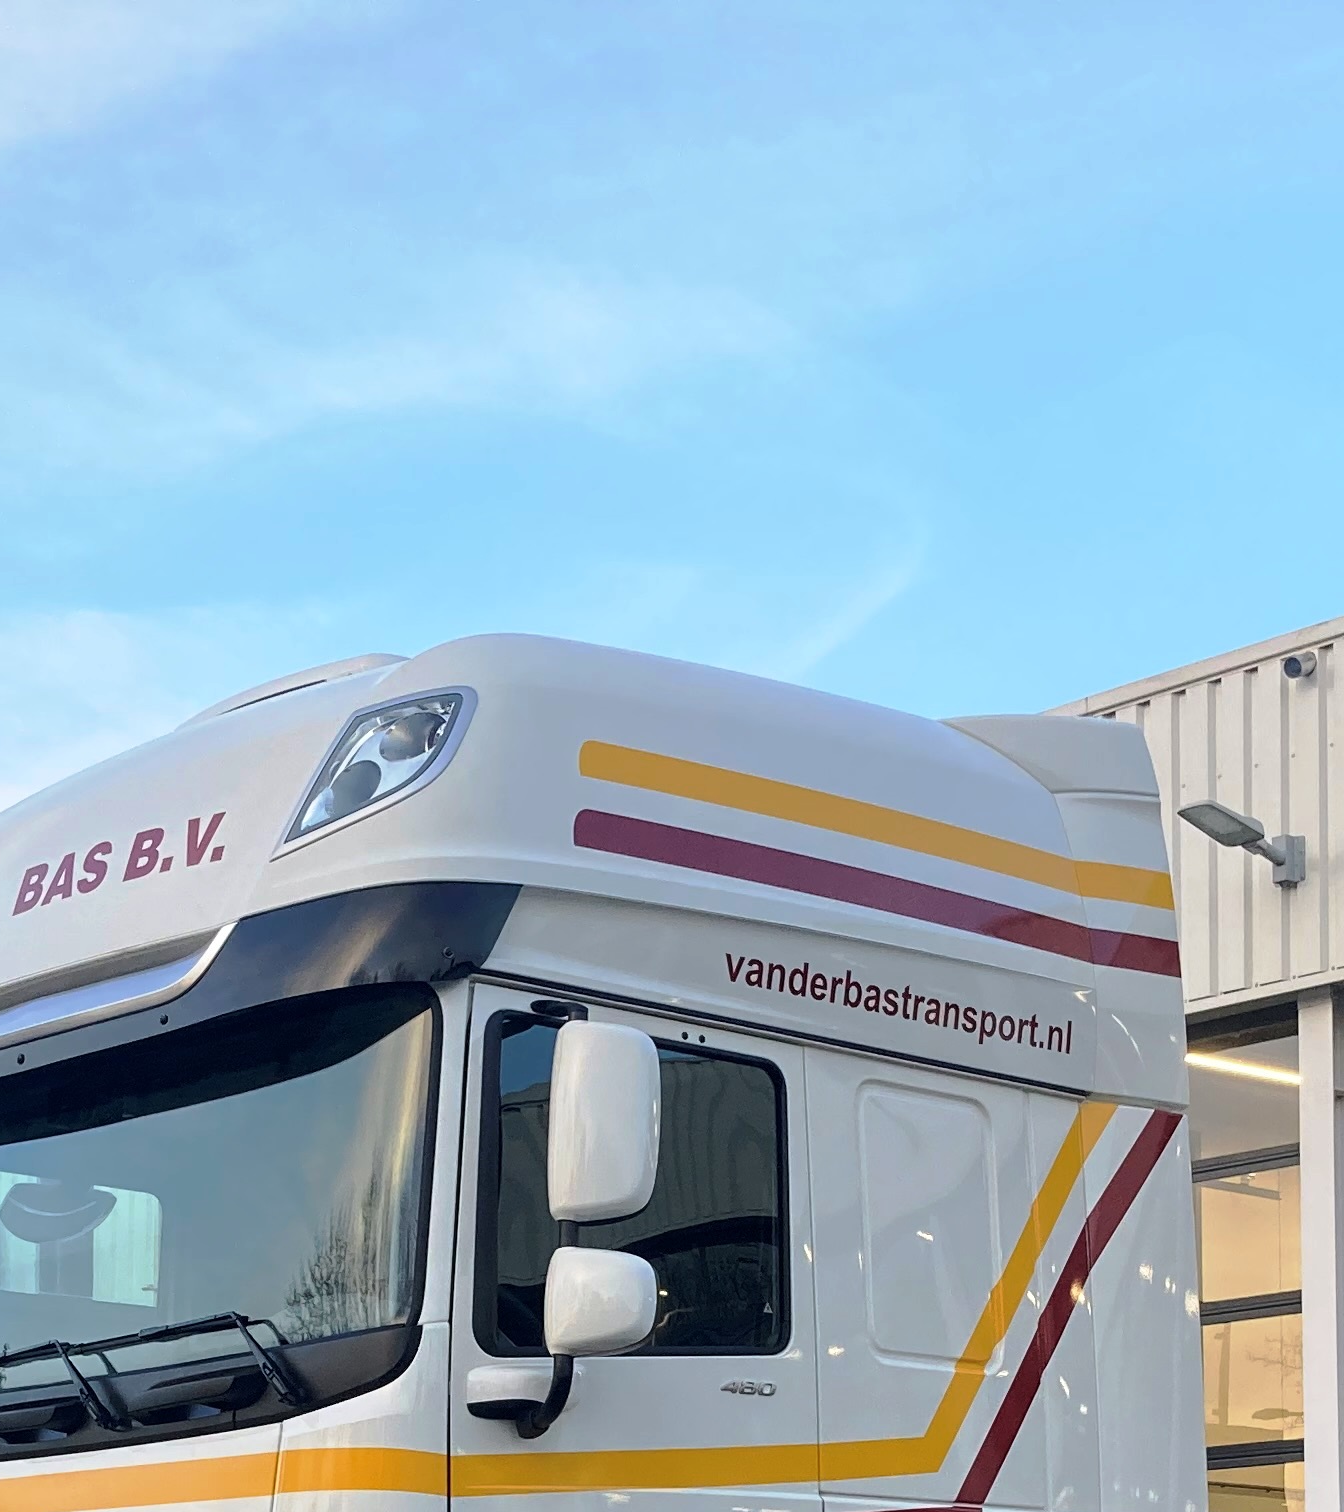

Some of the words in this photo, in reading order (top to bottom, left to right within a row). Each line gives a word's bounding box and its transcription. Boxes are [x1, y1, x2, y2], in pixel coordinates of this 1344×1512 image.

[11, 840, 113, 916] BAS
[122, 811, 227, 882] B.V.
[724, 952, 1073, 1055] vanderbastransport.nl
[720, 1380, 777, 1397] 480
